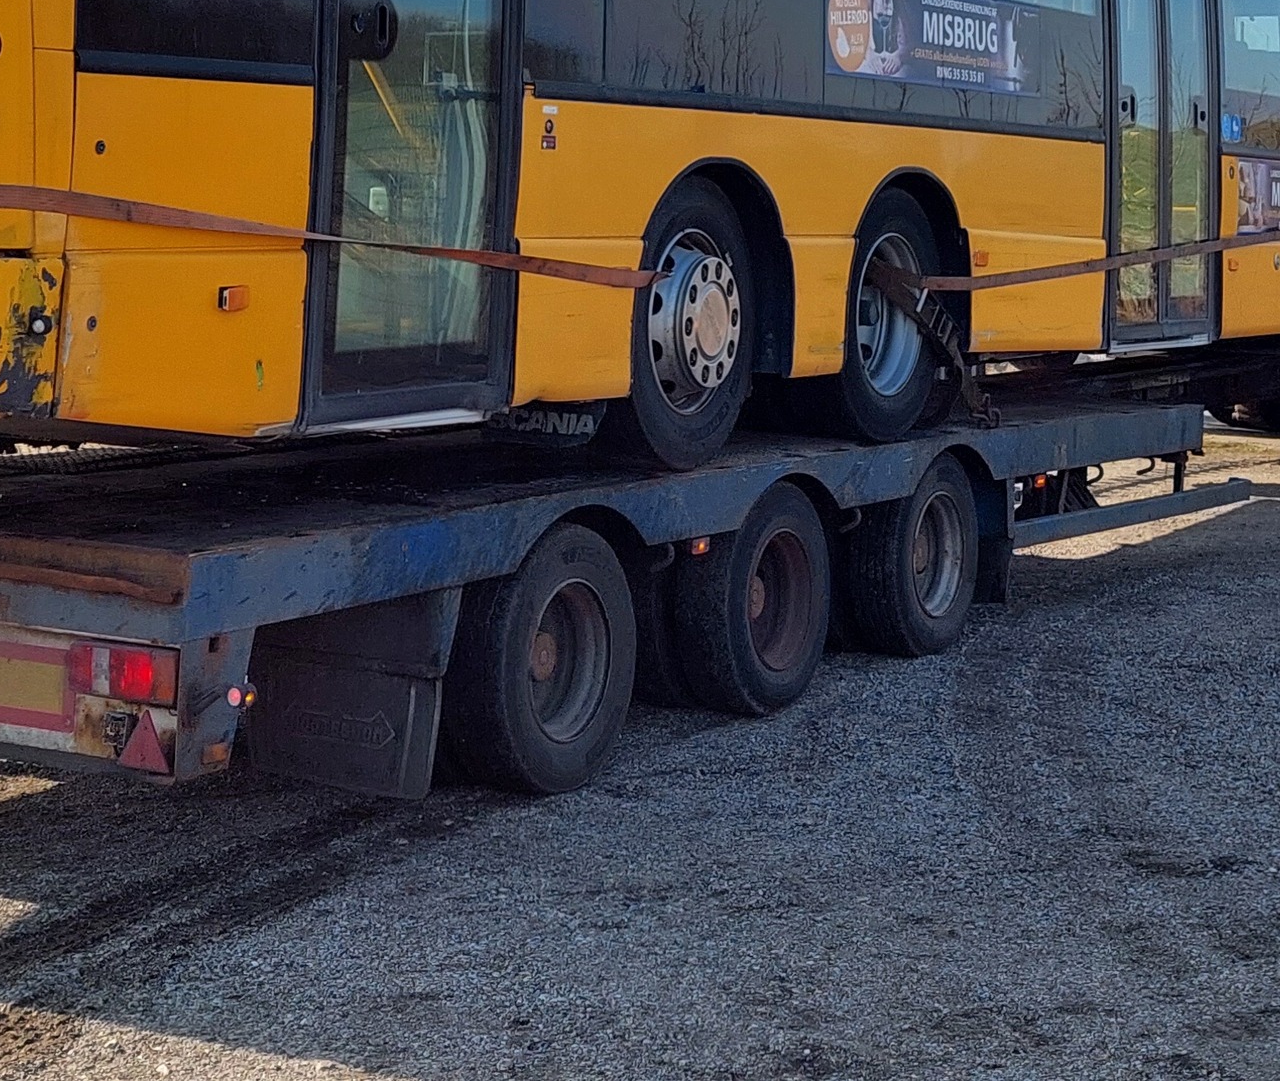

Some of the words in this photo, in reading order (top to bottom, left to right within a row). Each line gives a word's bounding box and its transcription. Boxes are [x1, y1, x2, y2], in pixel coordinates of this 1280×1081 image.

[830, 10, 869, 25] HILLERØD
[923, 10, 998, 54] MISBRUG
[936, 65, 953, 79] RING
